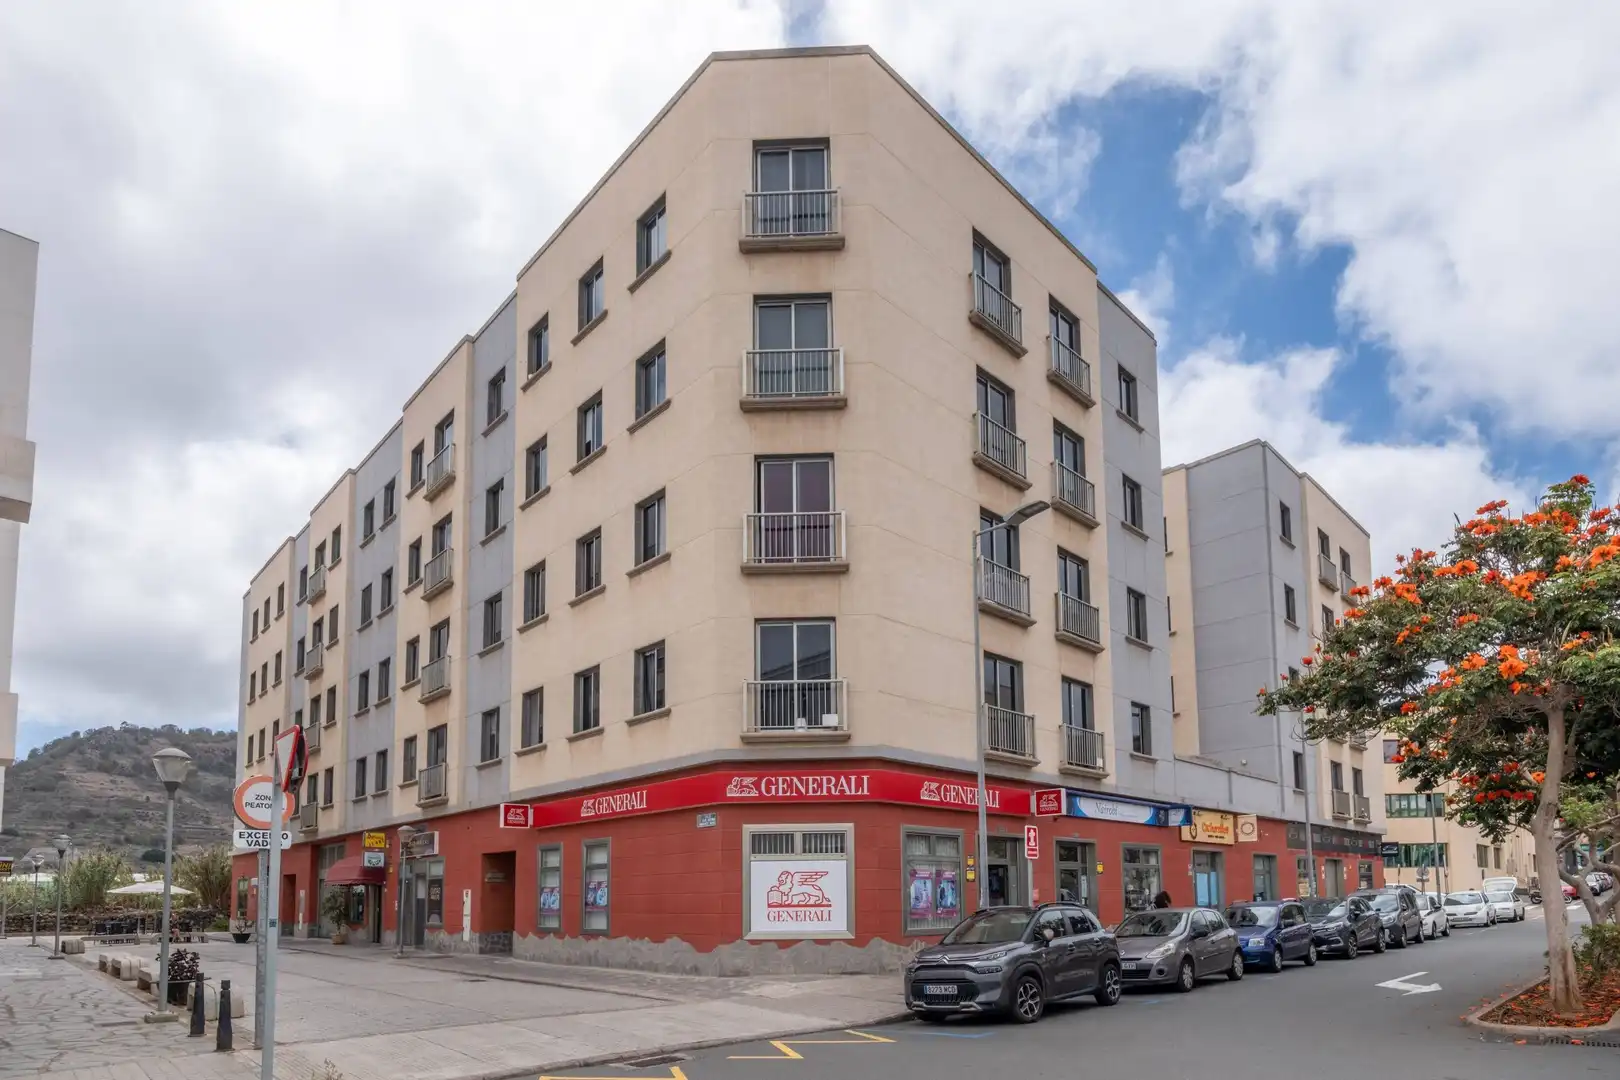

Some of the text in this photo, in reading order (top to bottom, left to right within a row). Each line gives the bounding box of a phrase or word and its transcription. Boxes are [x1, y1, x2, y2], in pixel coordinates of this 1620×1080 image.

[760, 775, 870, 797] GENERALI
[595, 790, 648, 815] GENERALI
[239, 831, 289, 840] EXCEO
[767, 910, 832, 922] GENERALI
